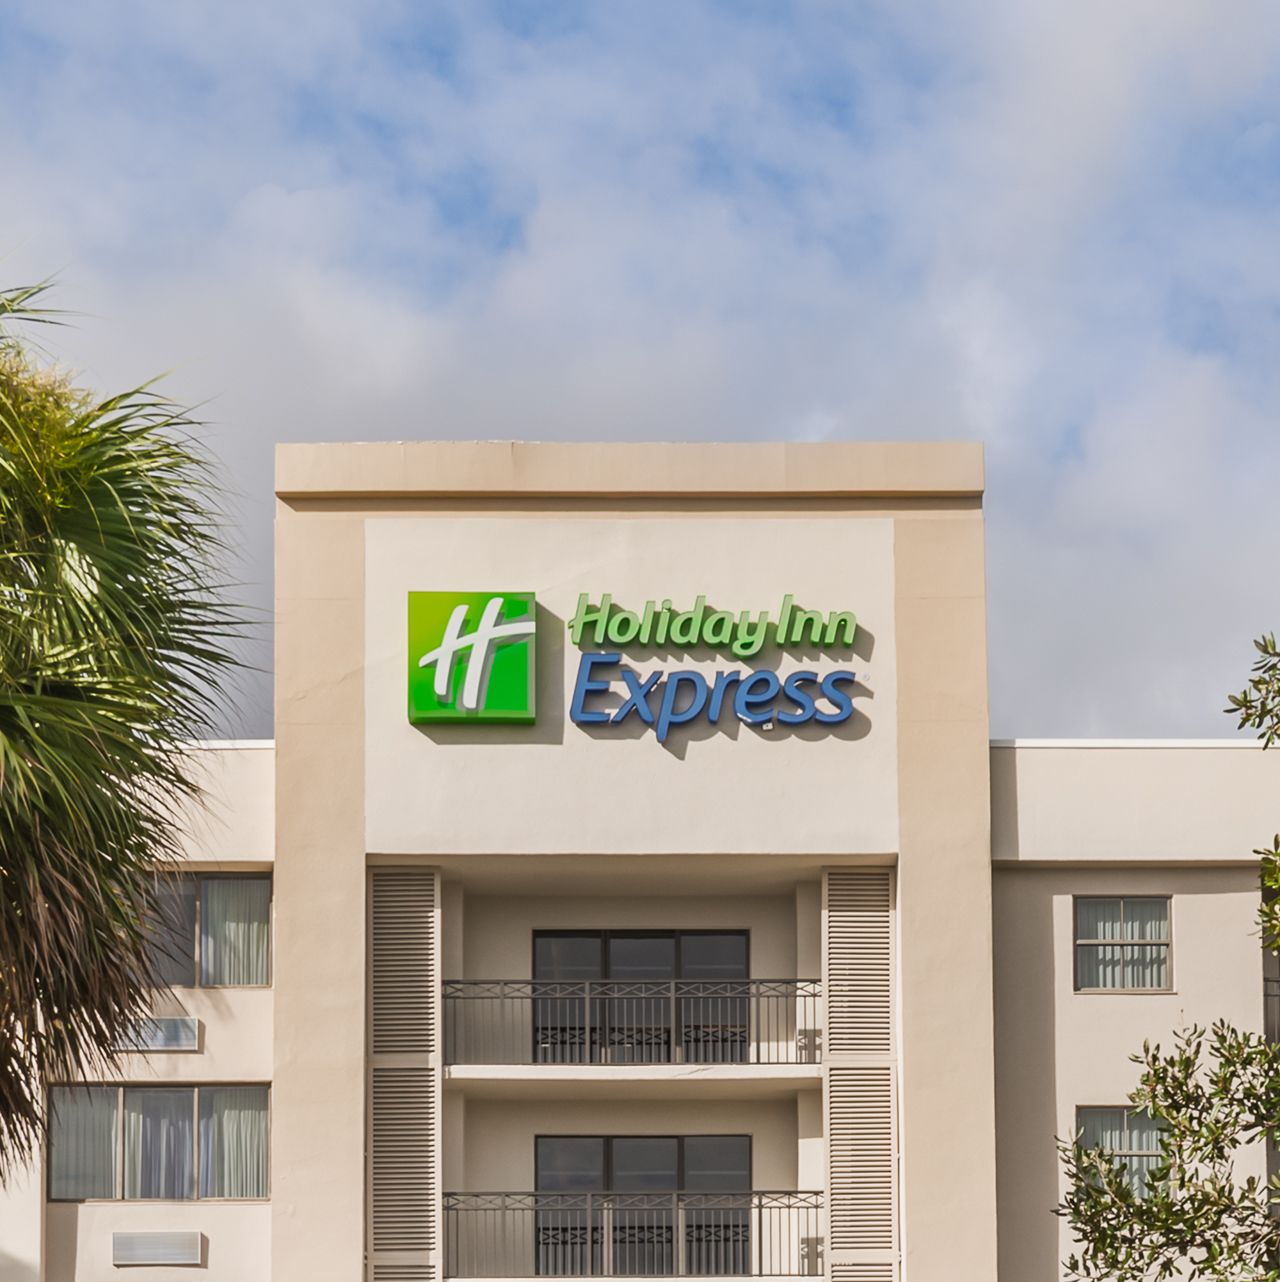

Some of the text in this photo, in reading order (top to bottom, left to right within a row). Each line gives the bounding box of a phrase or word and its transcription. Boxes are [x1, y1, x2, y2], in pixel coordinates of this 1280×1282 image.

[568, 593, 857, 658] Holiday Inn
[569, 652, 857, 743] Express
